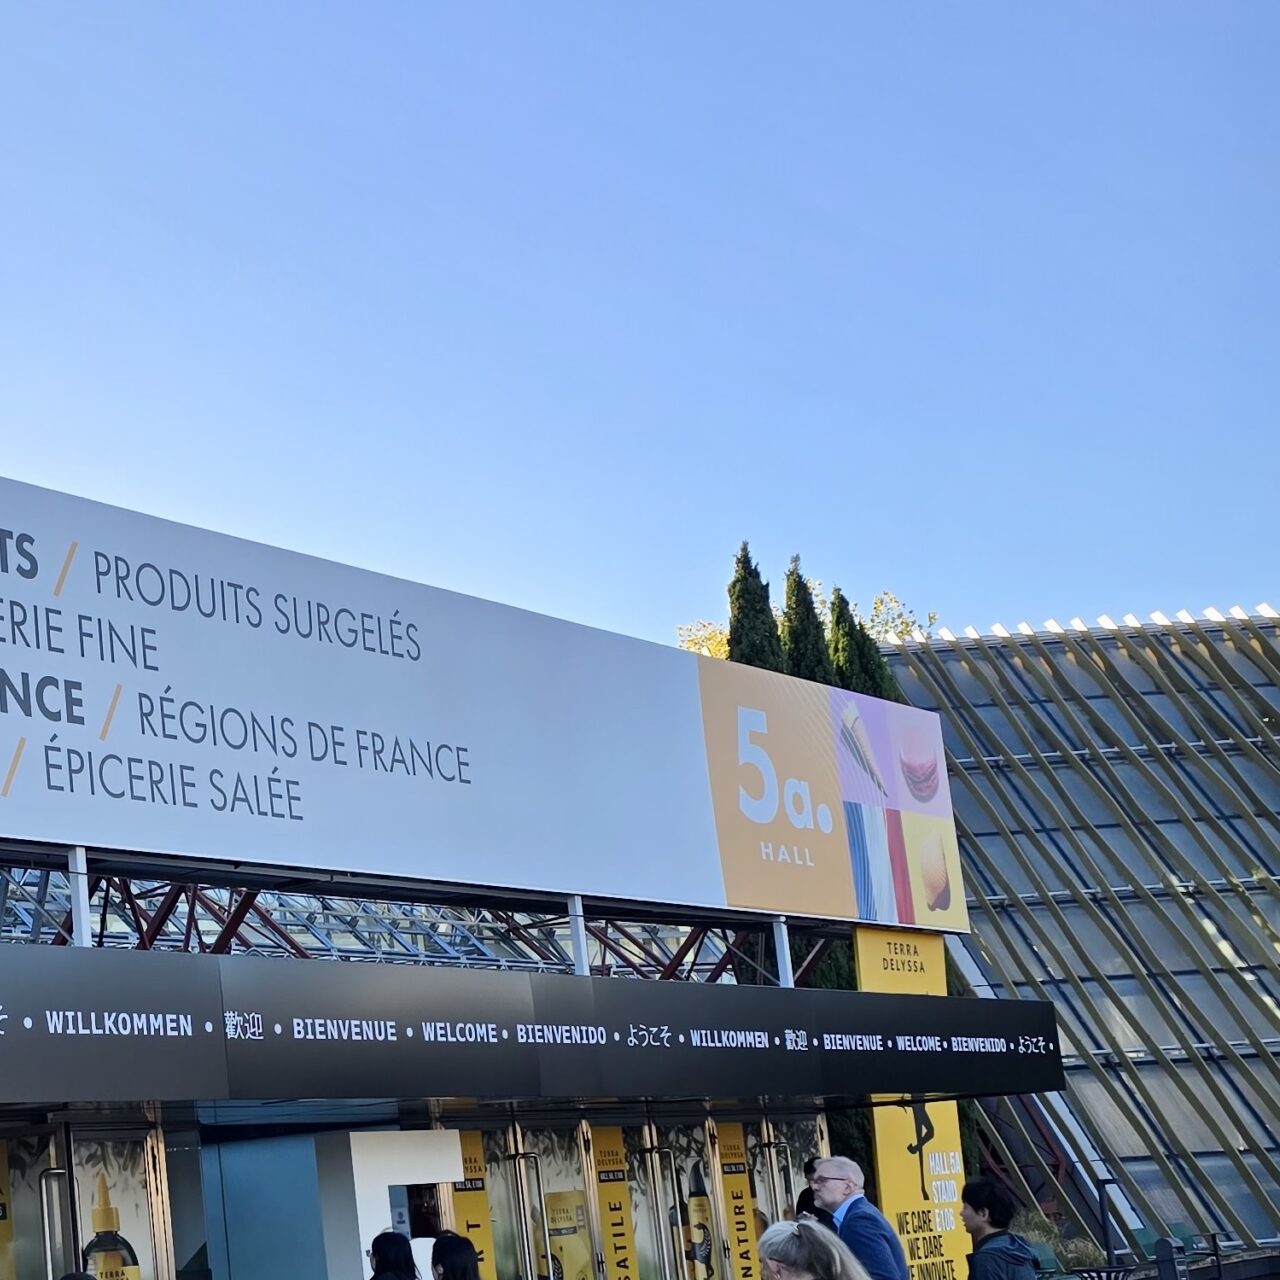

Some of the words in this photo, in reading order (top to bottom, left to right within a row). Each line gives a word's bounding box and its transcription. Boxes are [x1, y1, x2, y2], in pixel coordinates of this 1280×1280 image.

[93, 550, 262, 629] PRODUITS
[274, 594, 421, 662] SURGELÉS
[78, 613, 160, 672] FINE
[138, 685, 298, 759] RÉGIONS
[308, 721, 348, 767] DE
[356, 729, 472, 785] FRANCE
[44, 733, 198, 809] ÉPICERIE
[209, 766, 304, 822] SALÉE
[760, 841, 816, 867] HALL
[885, 941, 920, 957] TERRA
[882, 957, 926, 974] DELYSSA
[45, 1009, 194, 1037] WILLKOMMEN
[223, 1010, 264, 1040] 歡迎
[292, 1017, 398, 1042] BIENVENUE
[421, 1021, 499, 1044] WELCOME
[516, 1023, 607, 1046] BIENVENIDO
[690, 1028, 769, 1049] WILLKOMMEN
[822, 1032, 884, 1052] BIENVENUE
[895, 1034, 942, 1053] WELCOME
[951, 1035, 1008, 1054] BIENVENIDO
[928, 1152, 950, 1176] HALL
[931, 1180, 958, 1203] STAND
[896, 1211, 911, 1235] WE
[911, 1209, 934, 1234] CARE
[907, 1237, 922, 1261] WE
[922, 1234, 945, 1260] DARE
[99, 1269, 126, 1279] TERRA
